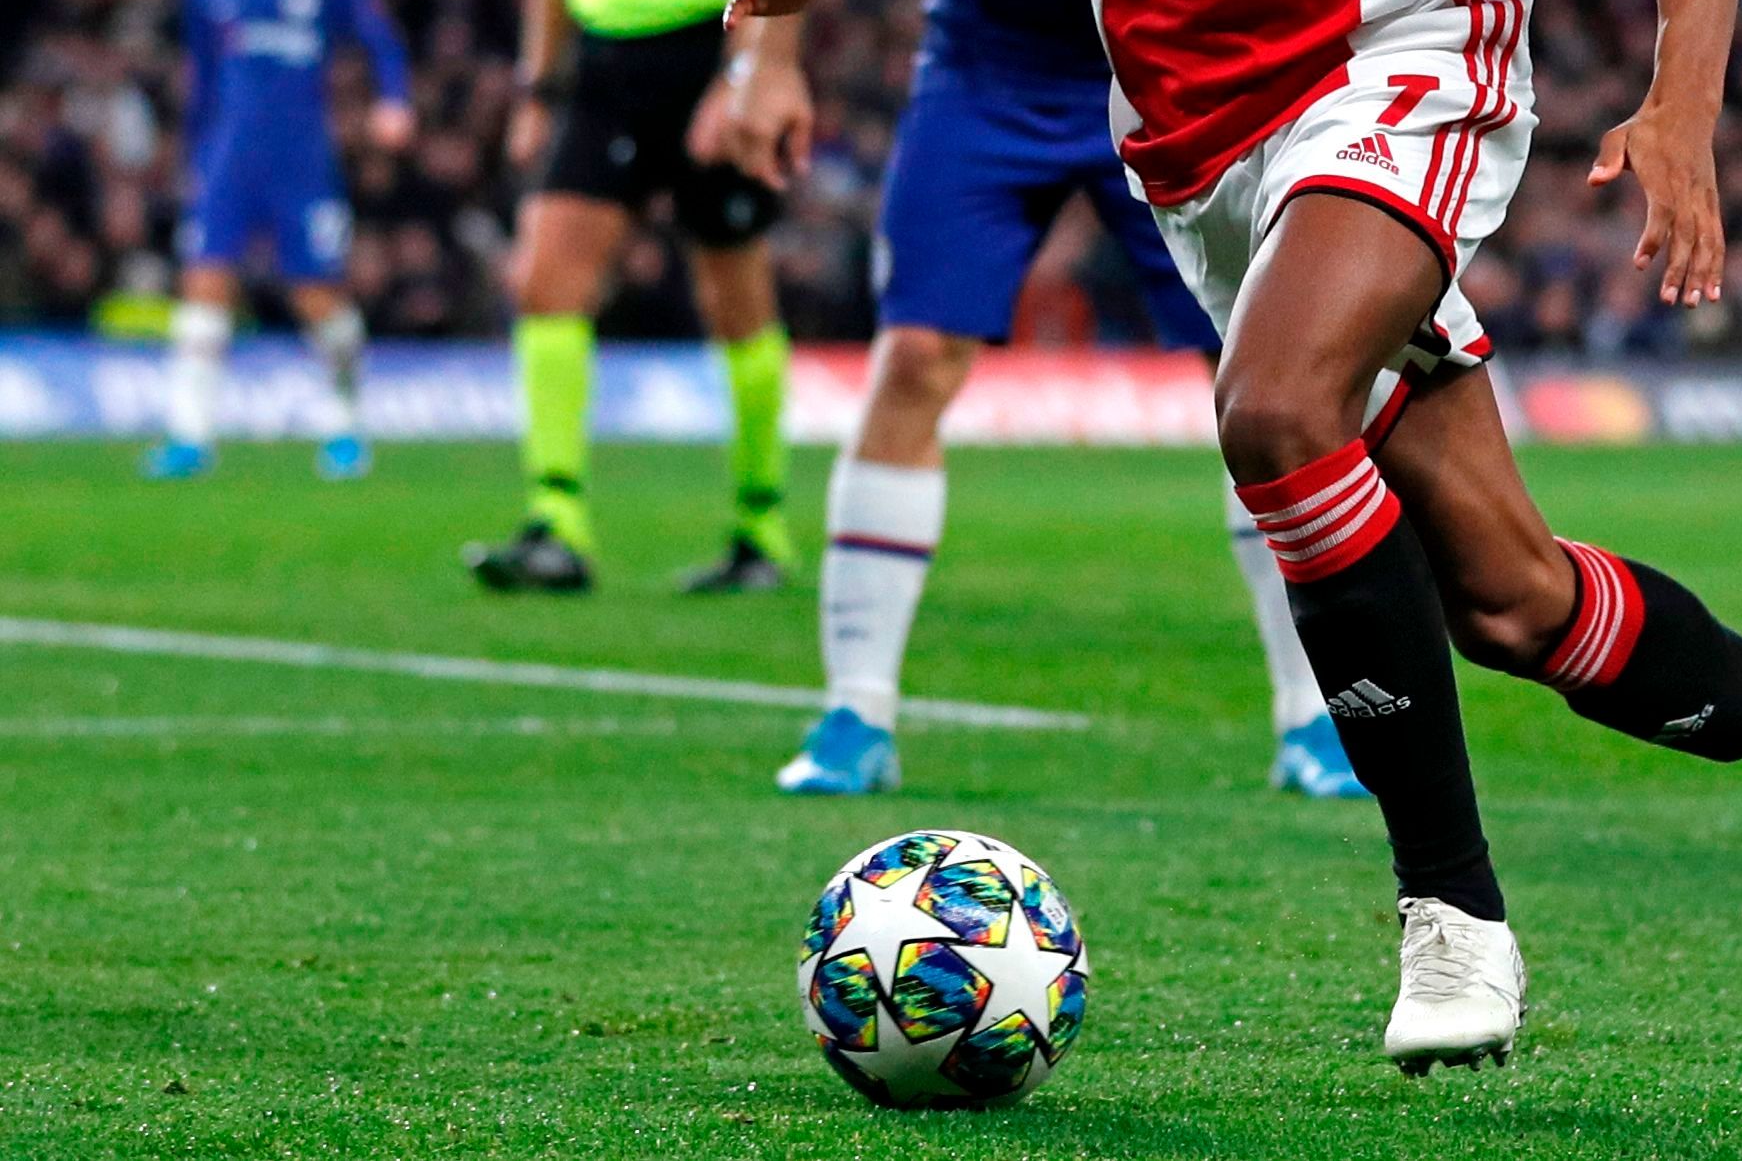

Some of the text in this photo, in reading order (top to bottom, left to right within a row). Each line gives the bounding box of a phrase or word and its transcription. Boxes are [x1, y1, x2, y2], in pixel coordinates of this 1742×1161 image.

[1375, 74, 1440, 128] 7
[1336, 147, 1399, 176] adidas
[1326, 696, 1412, 718] adidas
